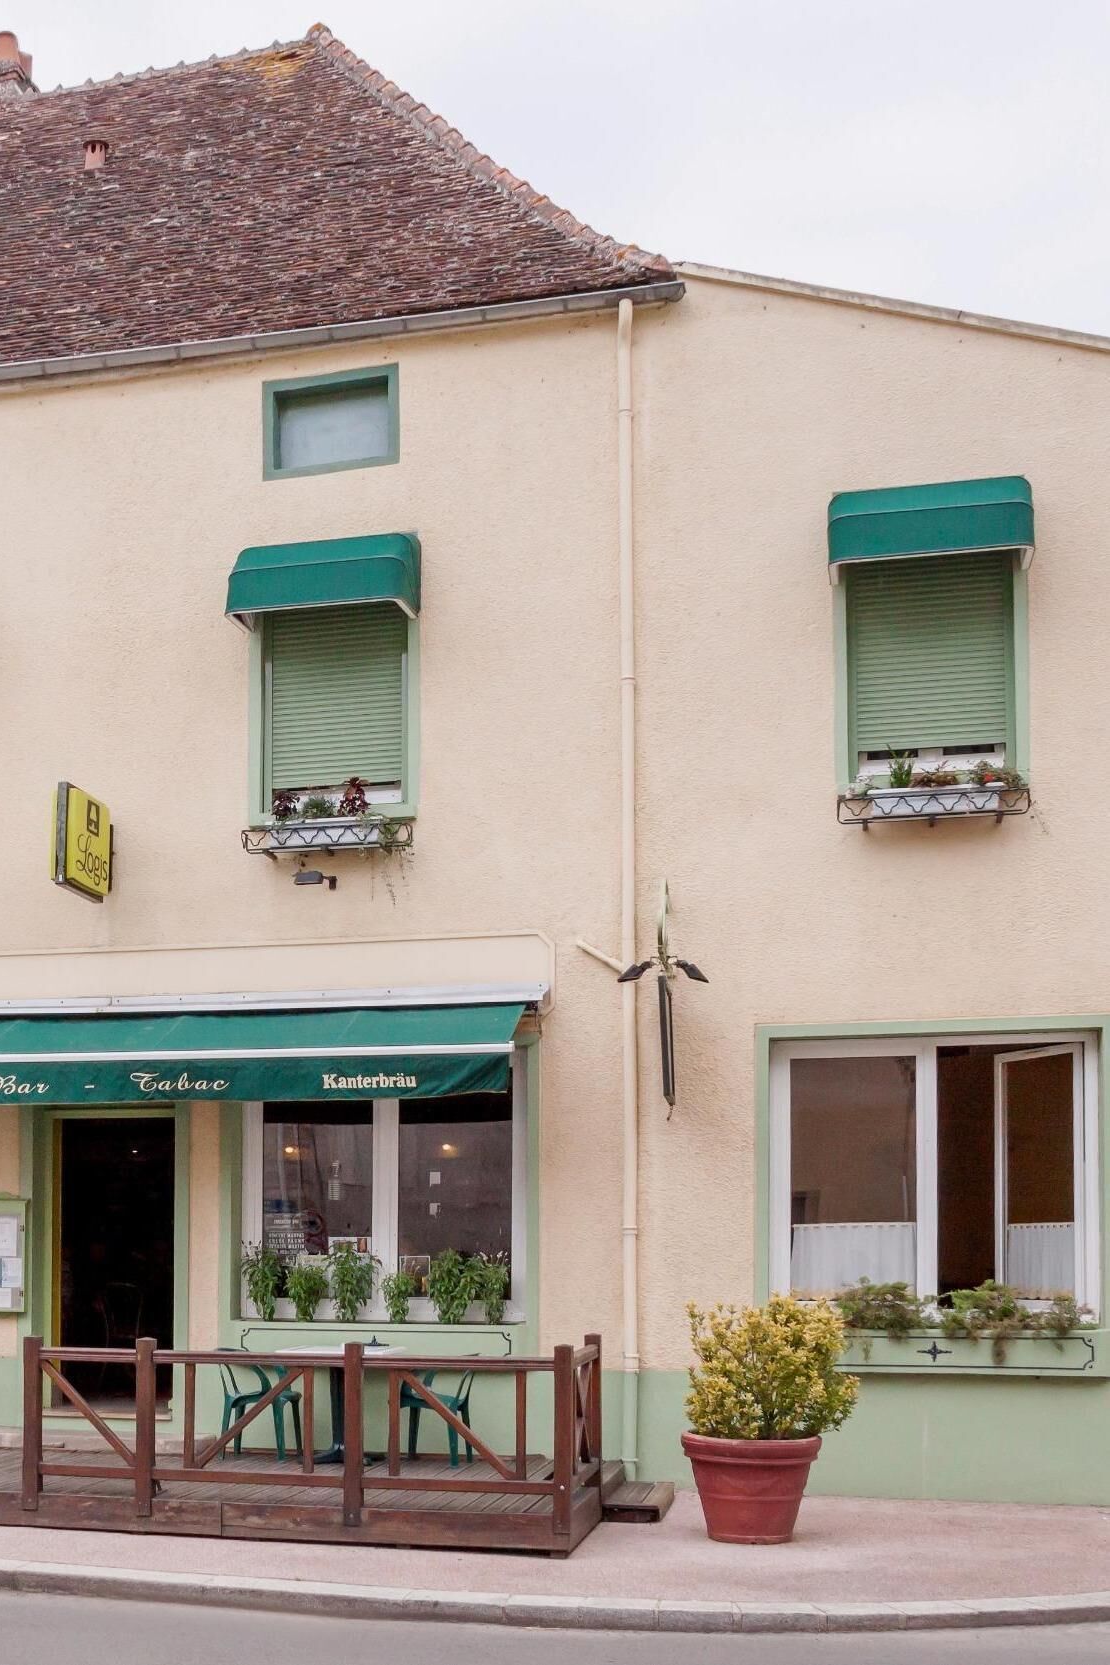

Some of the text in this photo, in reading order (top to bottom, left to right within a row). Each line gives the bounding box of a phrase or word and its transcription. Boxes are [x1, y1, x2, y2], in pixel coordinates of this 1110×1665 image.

[76, 833, 108, 886] Logis
[130, 1072, 230, 1093] Tabac
[322, 1073, 417, 1089] Kanterbräu
